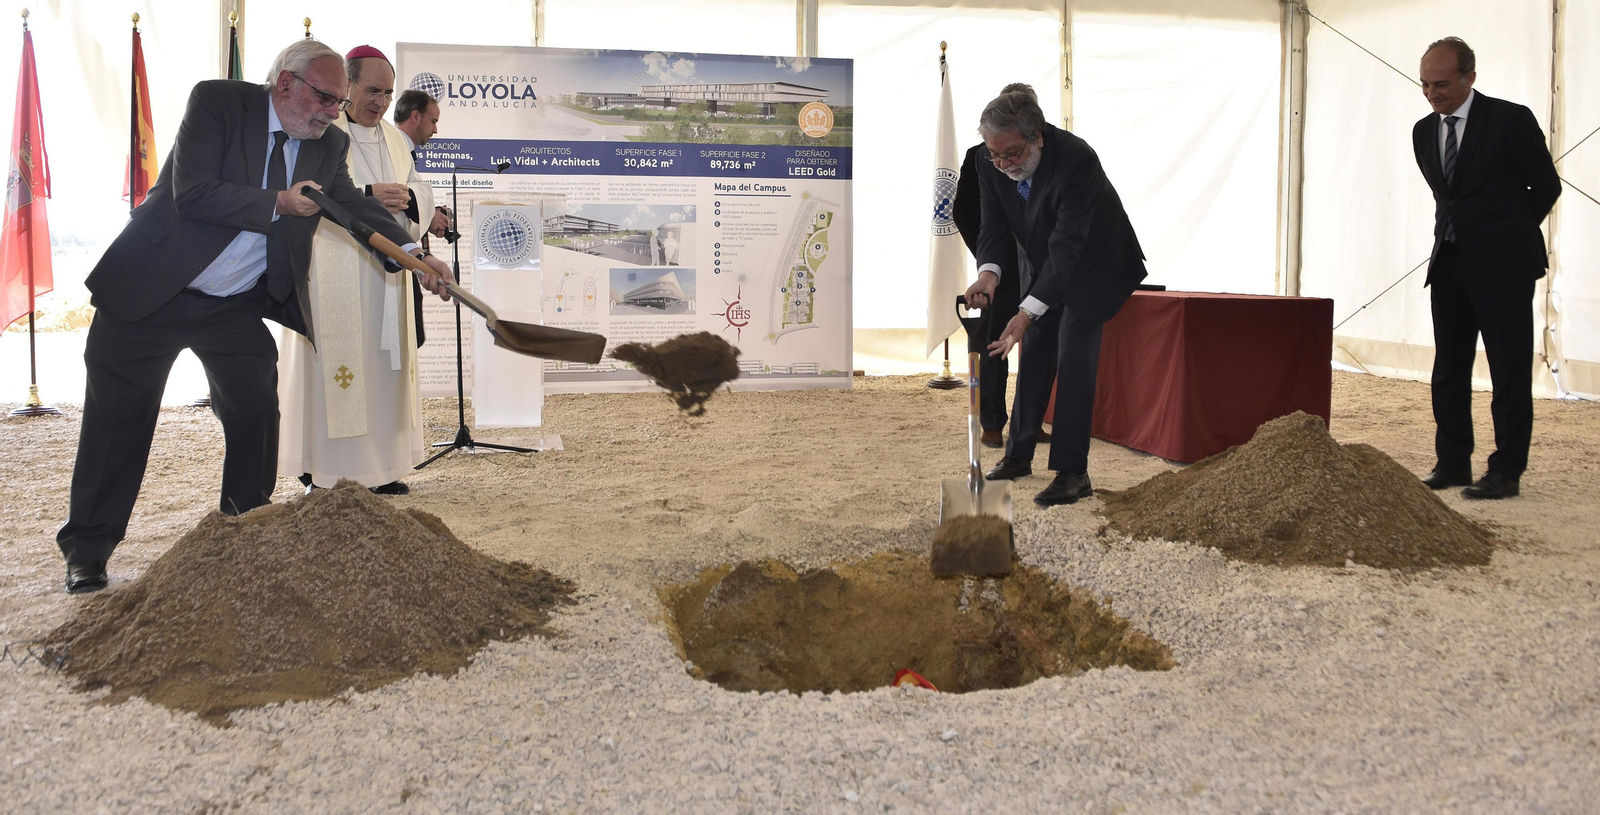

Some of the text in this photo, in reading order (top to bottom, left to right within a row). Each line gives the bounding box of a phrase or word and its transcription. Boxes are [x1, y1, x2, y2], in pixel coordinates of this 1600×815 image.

[448, 74, 538, 84] UNIVERSIDAD
[448, 82, 538, 100] LOYOLA
[449, 100, 537, 109] ANDALUCÍA
[420, 142, 461, 150] UBICACIÓN
[520, 147, 571, 155] ARQUITECTOS
[426, 151, 474, 161] Hermanas,
[616, 148, 682, 157] SUPERFICIE FASE 1
[700, 150, 766, 160] SUPERFICIE FASE 2
[795, 149, 830, 158] DISEÑADO
[425, 160, 455, 168] Sevilla
[491, 156, 511, 165] Luis
[514, 156, 538, 165] Vidal
[551, 157, 600, 167] Architects
[624, 158, 673, 168] 30,842 m²
[710, 160, 756, 170] 89,736 m²
[803, 158, 838, 166] OBTENER
[788, 167, 836, 177] LEED Gold
[714, 183, 786, 193] Mapa del Campus
[513, 213, 529, 229] FIDES
[481, 213, 501, 249] HUMANITAS
[487, 250, 516, 264] UTILITAS
[731, 309, 751, 320] IHS
